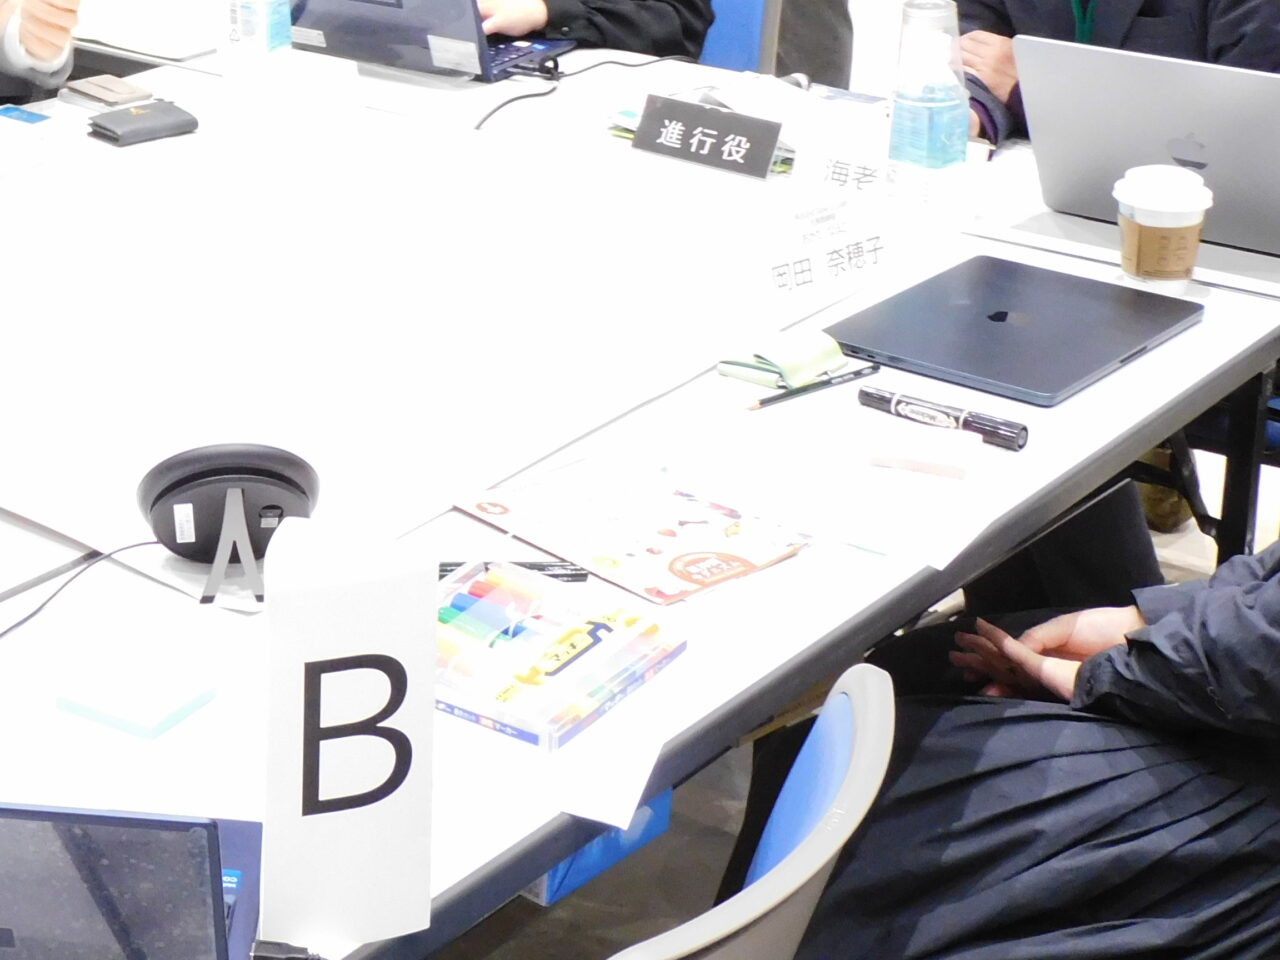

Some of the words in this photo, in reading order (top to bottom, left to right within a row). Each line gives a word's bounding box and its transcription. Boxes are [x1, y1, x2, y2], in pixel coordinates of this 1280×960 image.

[655, 118, 752, 165] 進行役
[301, 652, 414, 817] B
